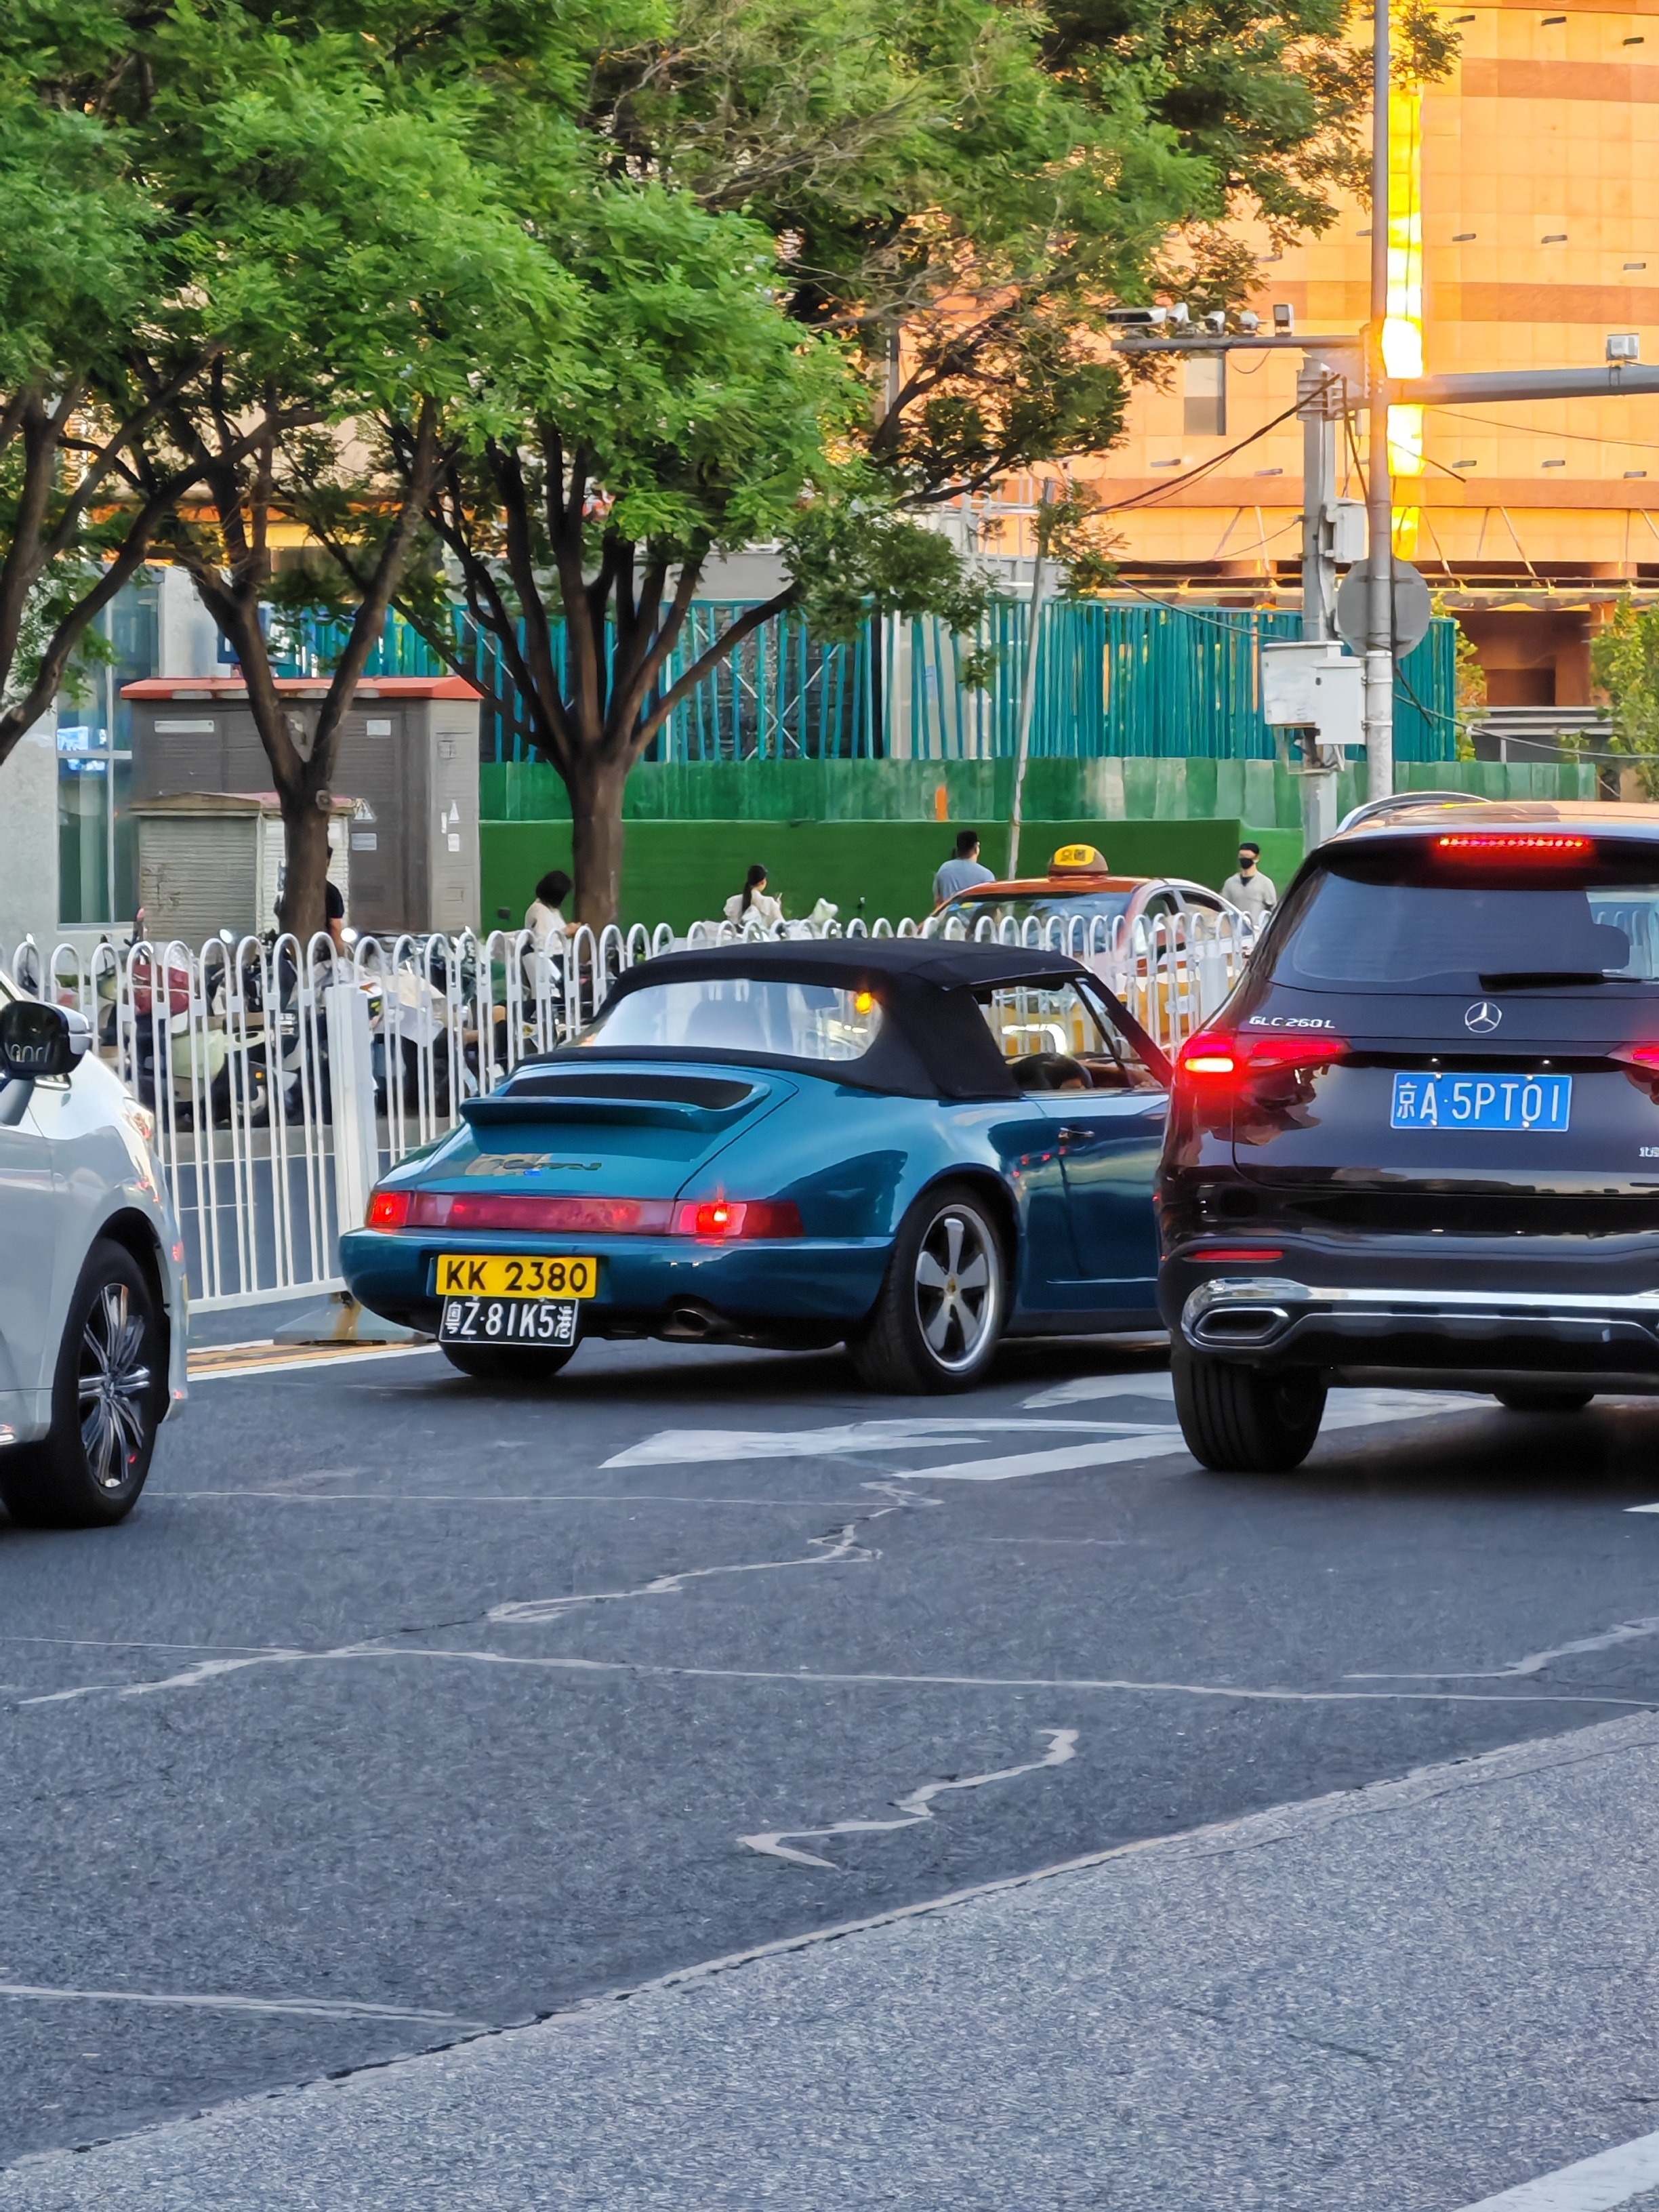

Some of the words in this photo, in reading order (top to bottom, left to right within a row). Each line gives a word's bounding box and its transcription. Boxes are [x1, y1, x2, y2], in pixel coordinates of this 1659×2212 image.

[1249, 1016, 1284, 1026] GLC
[446, 1261, 487, 1290] KK
[505, 1262, 588, 1292] 2380
